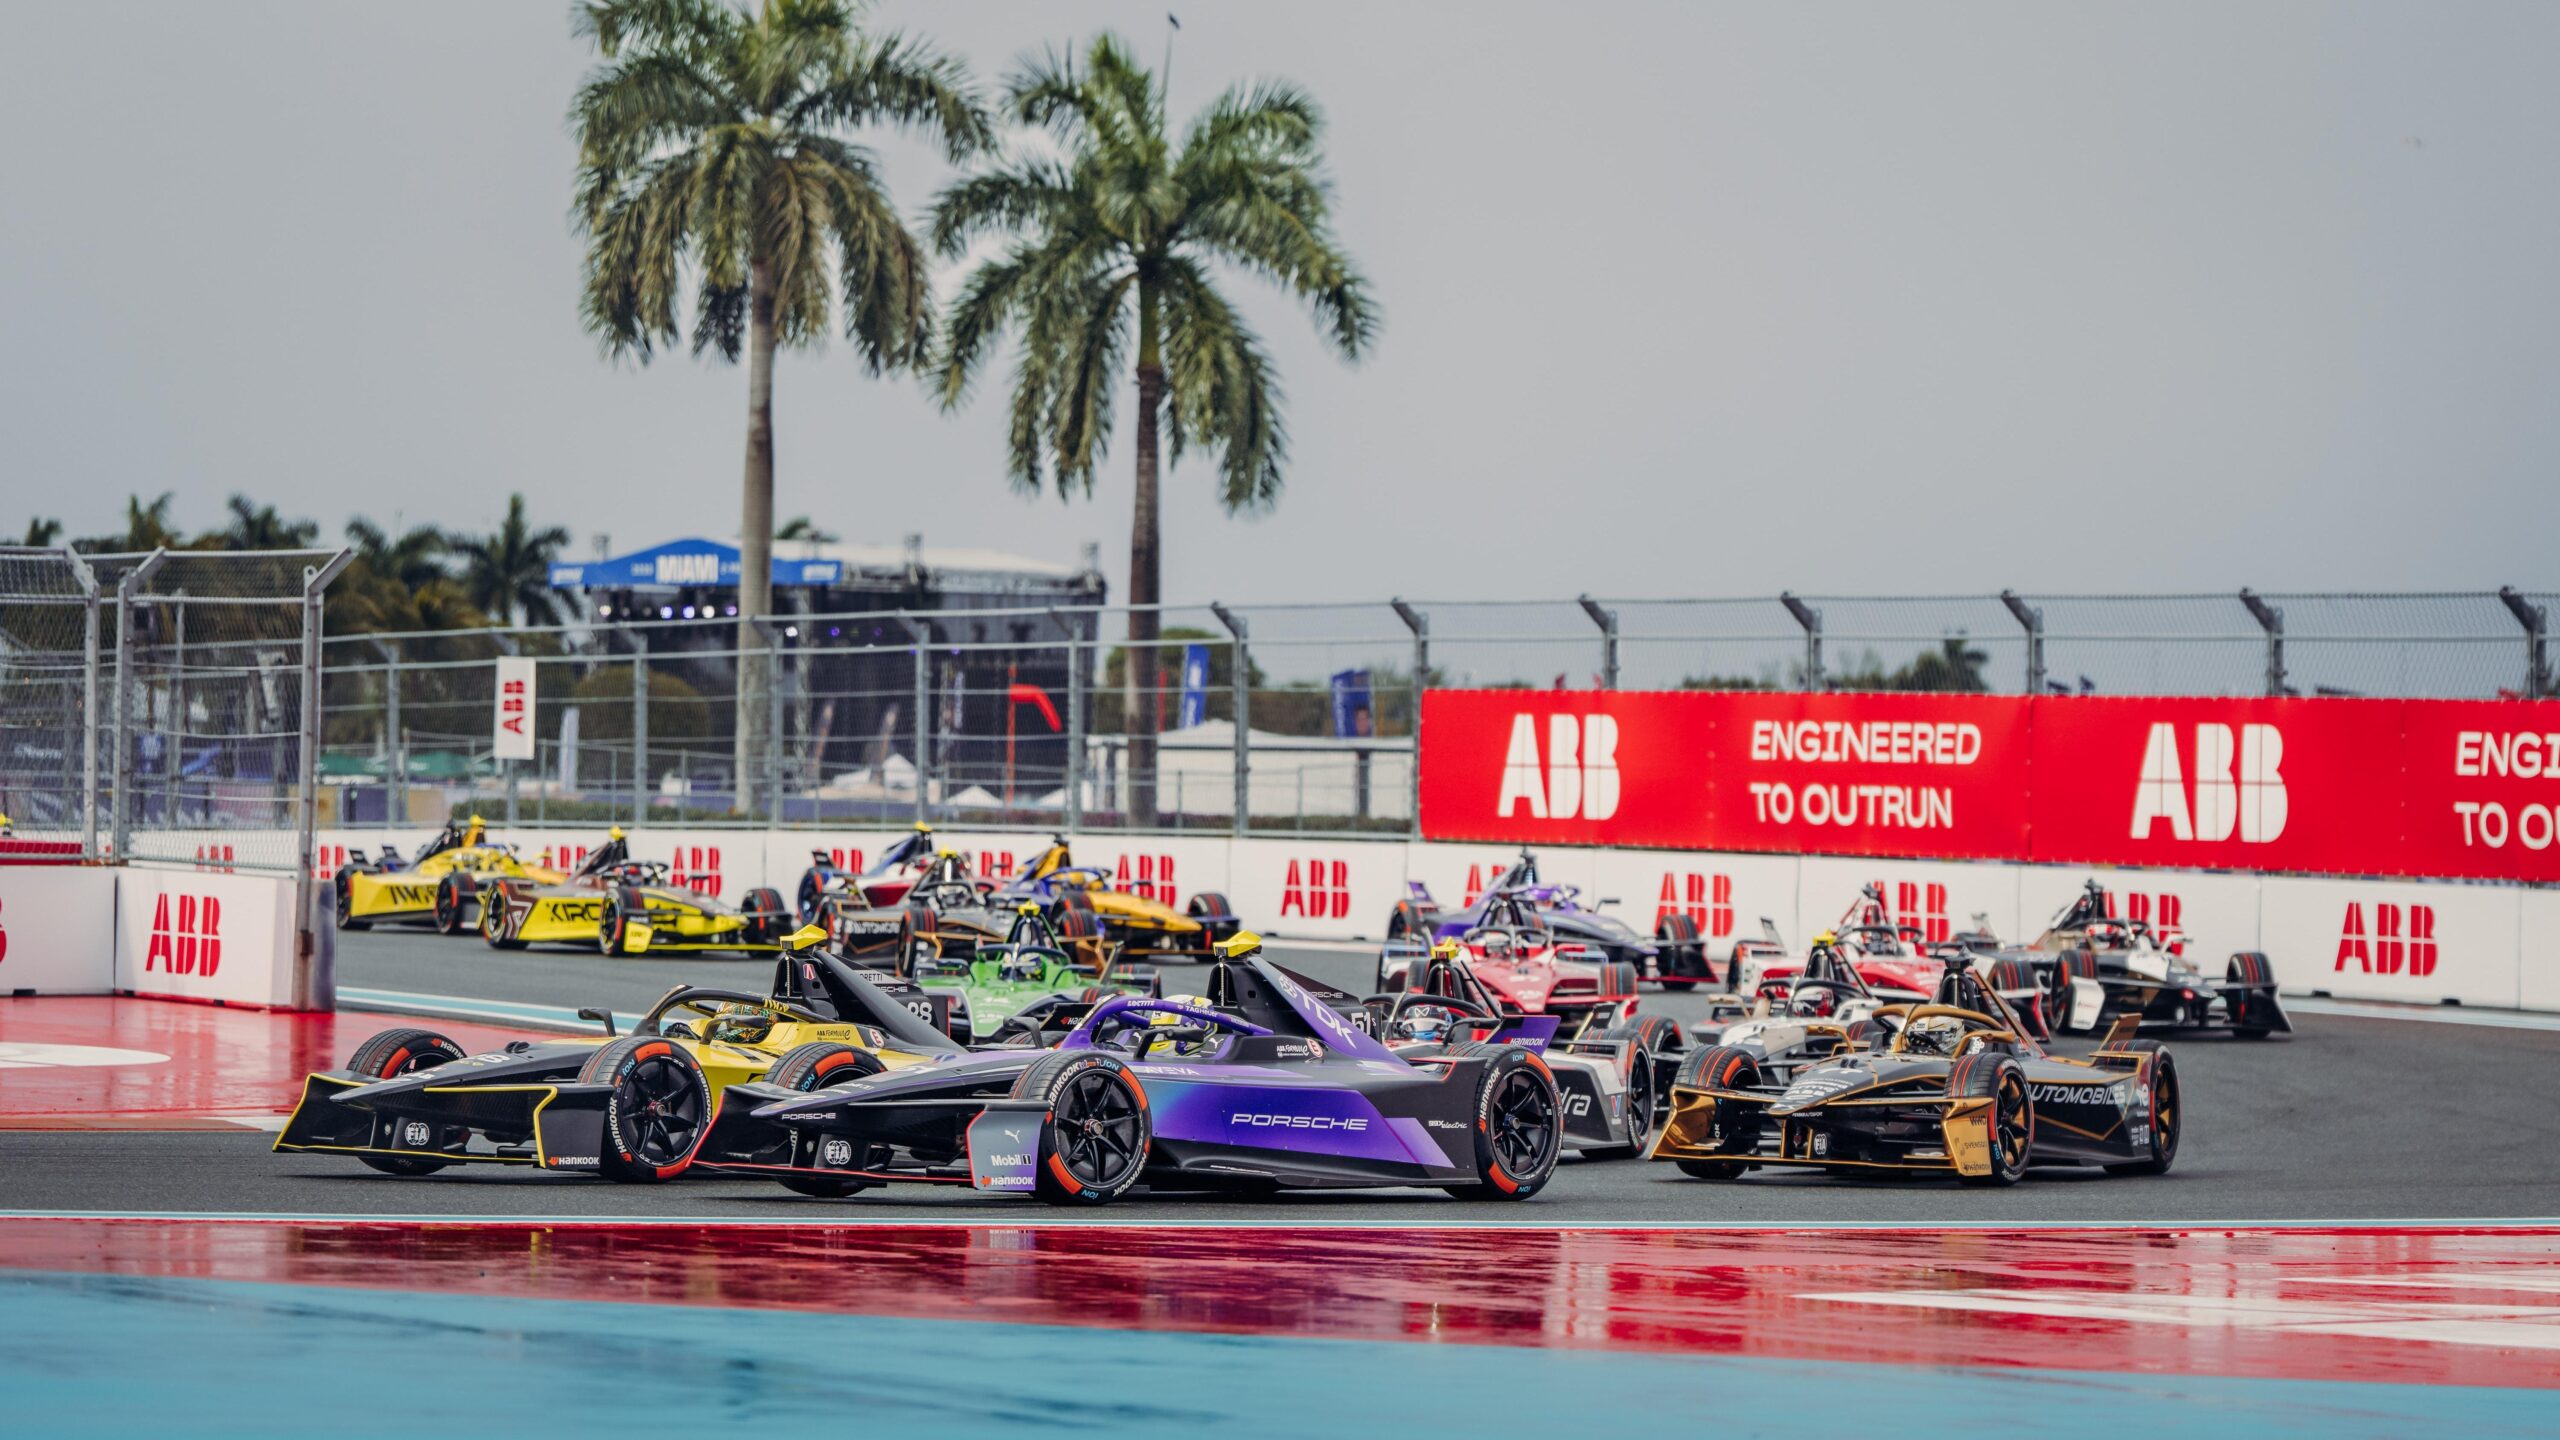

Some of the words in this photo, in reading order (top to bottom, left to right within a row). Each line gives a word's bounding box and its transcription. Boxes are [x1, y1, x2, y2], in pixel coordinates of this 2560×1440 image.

[656, 554, 719, 584] MIAMI
[502, 680, 525, 735] ABB
[1499, 713, 1620, 819] ABB
[1751, 720, 1981, 765] ENGINEERED
[1750, 782, 1794, 823] TO
[1801, 784, 1952, 828] OUTRUN
[2132, 723, 2288, 842] ABB
[2454, 801, 2508, 848] TO
[671, 847, 722, 897] ABB
[1115, 854, 1177, 909] ABB
[1281, 859, 1350, 919] ABB
[1655, 873, 1734, 938] ABB
[145, 893, 222, 978] ABB
[2335, 902, 2438, 977] ABB
[1295, 986, 1357, 1049] TDK
[1351, 1011, 1371, 1036] 51
[406, 1125, 428, 1142] FIA
[782, 1112, 836, 1121] PORSCHE
[1231, 1113, 1368, 1131] PORSCHE
[827, 1144, 850, 1161] FIA
[991, 1154, 1021, 1166] Mobil
[1023, 1154, 1032, 1165] 1
